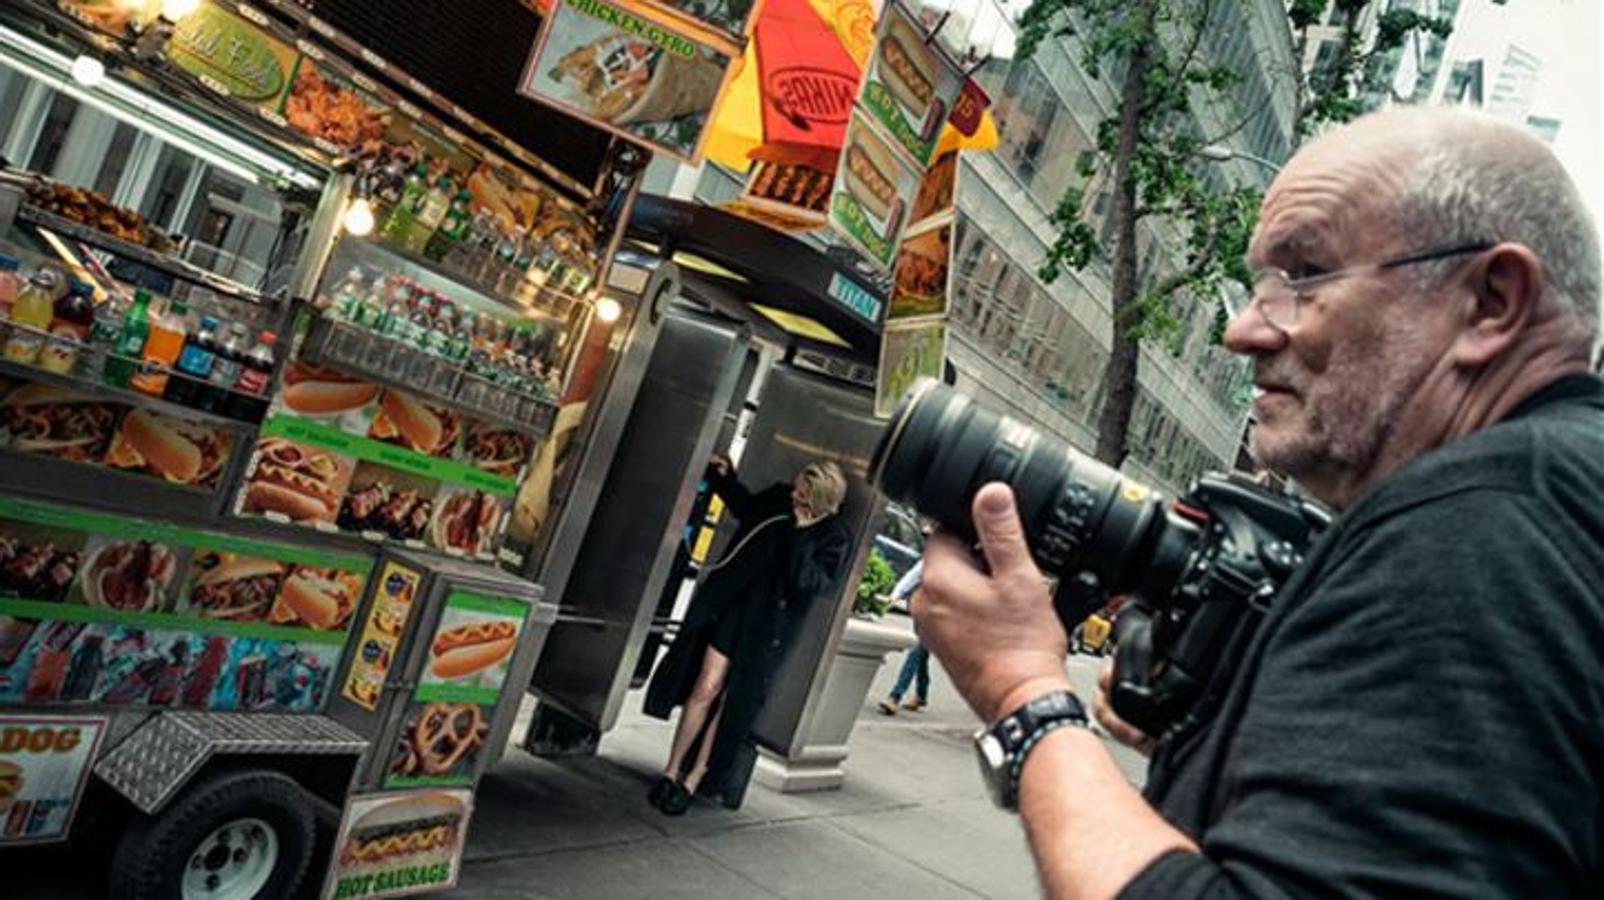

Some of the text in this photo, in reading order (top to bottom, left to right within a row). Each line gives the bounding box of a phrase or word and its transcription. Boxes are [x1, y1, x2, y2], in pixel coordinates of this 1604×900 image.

[647, 25, 695, 57] GYRO
[0, 726, 81, 754] DOG
[334, 862, 449, 899] HOT SAUSAGE
